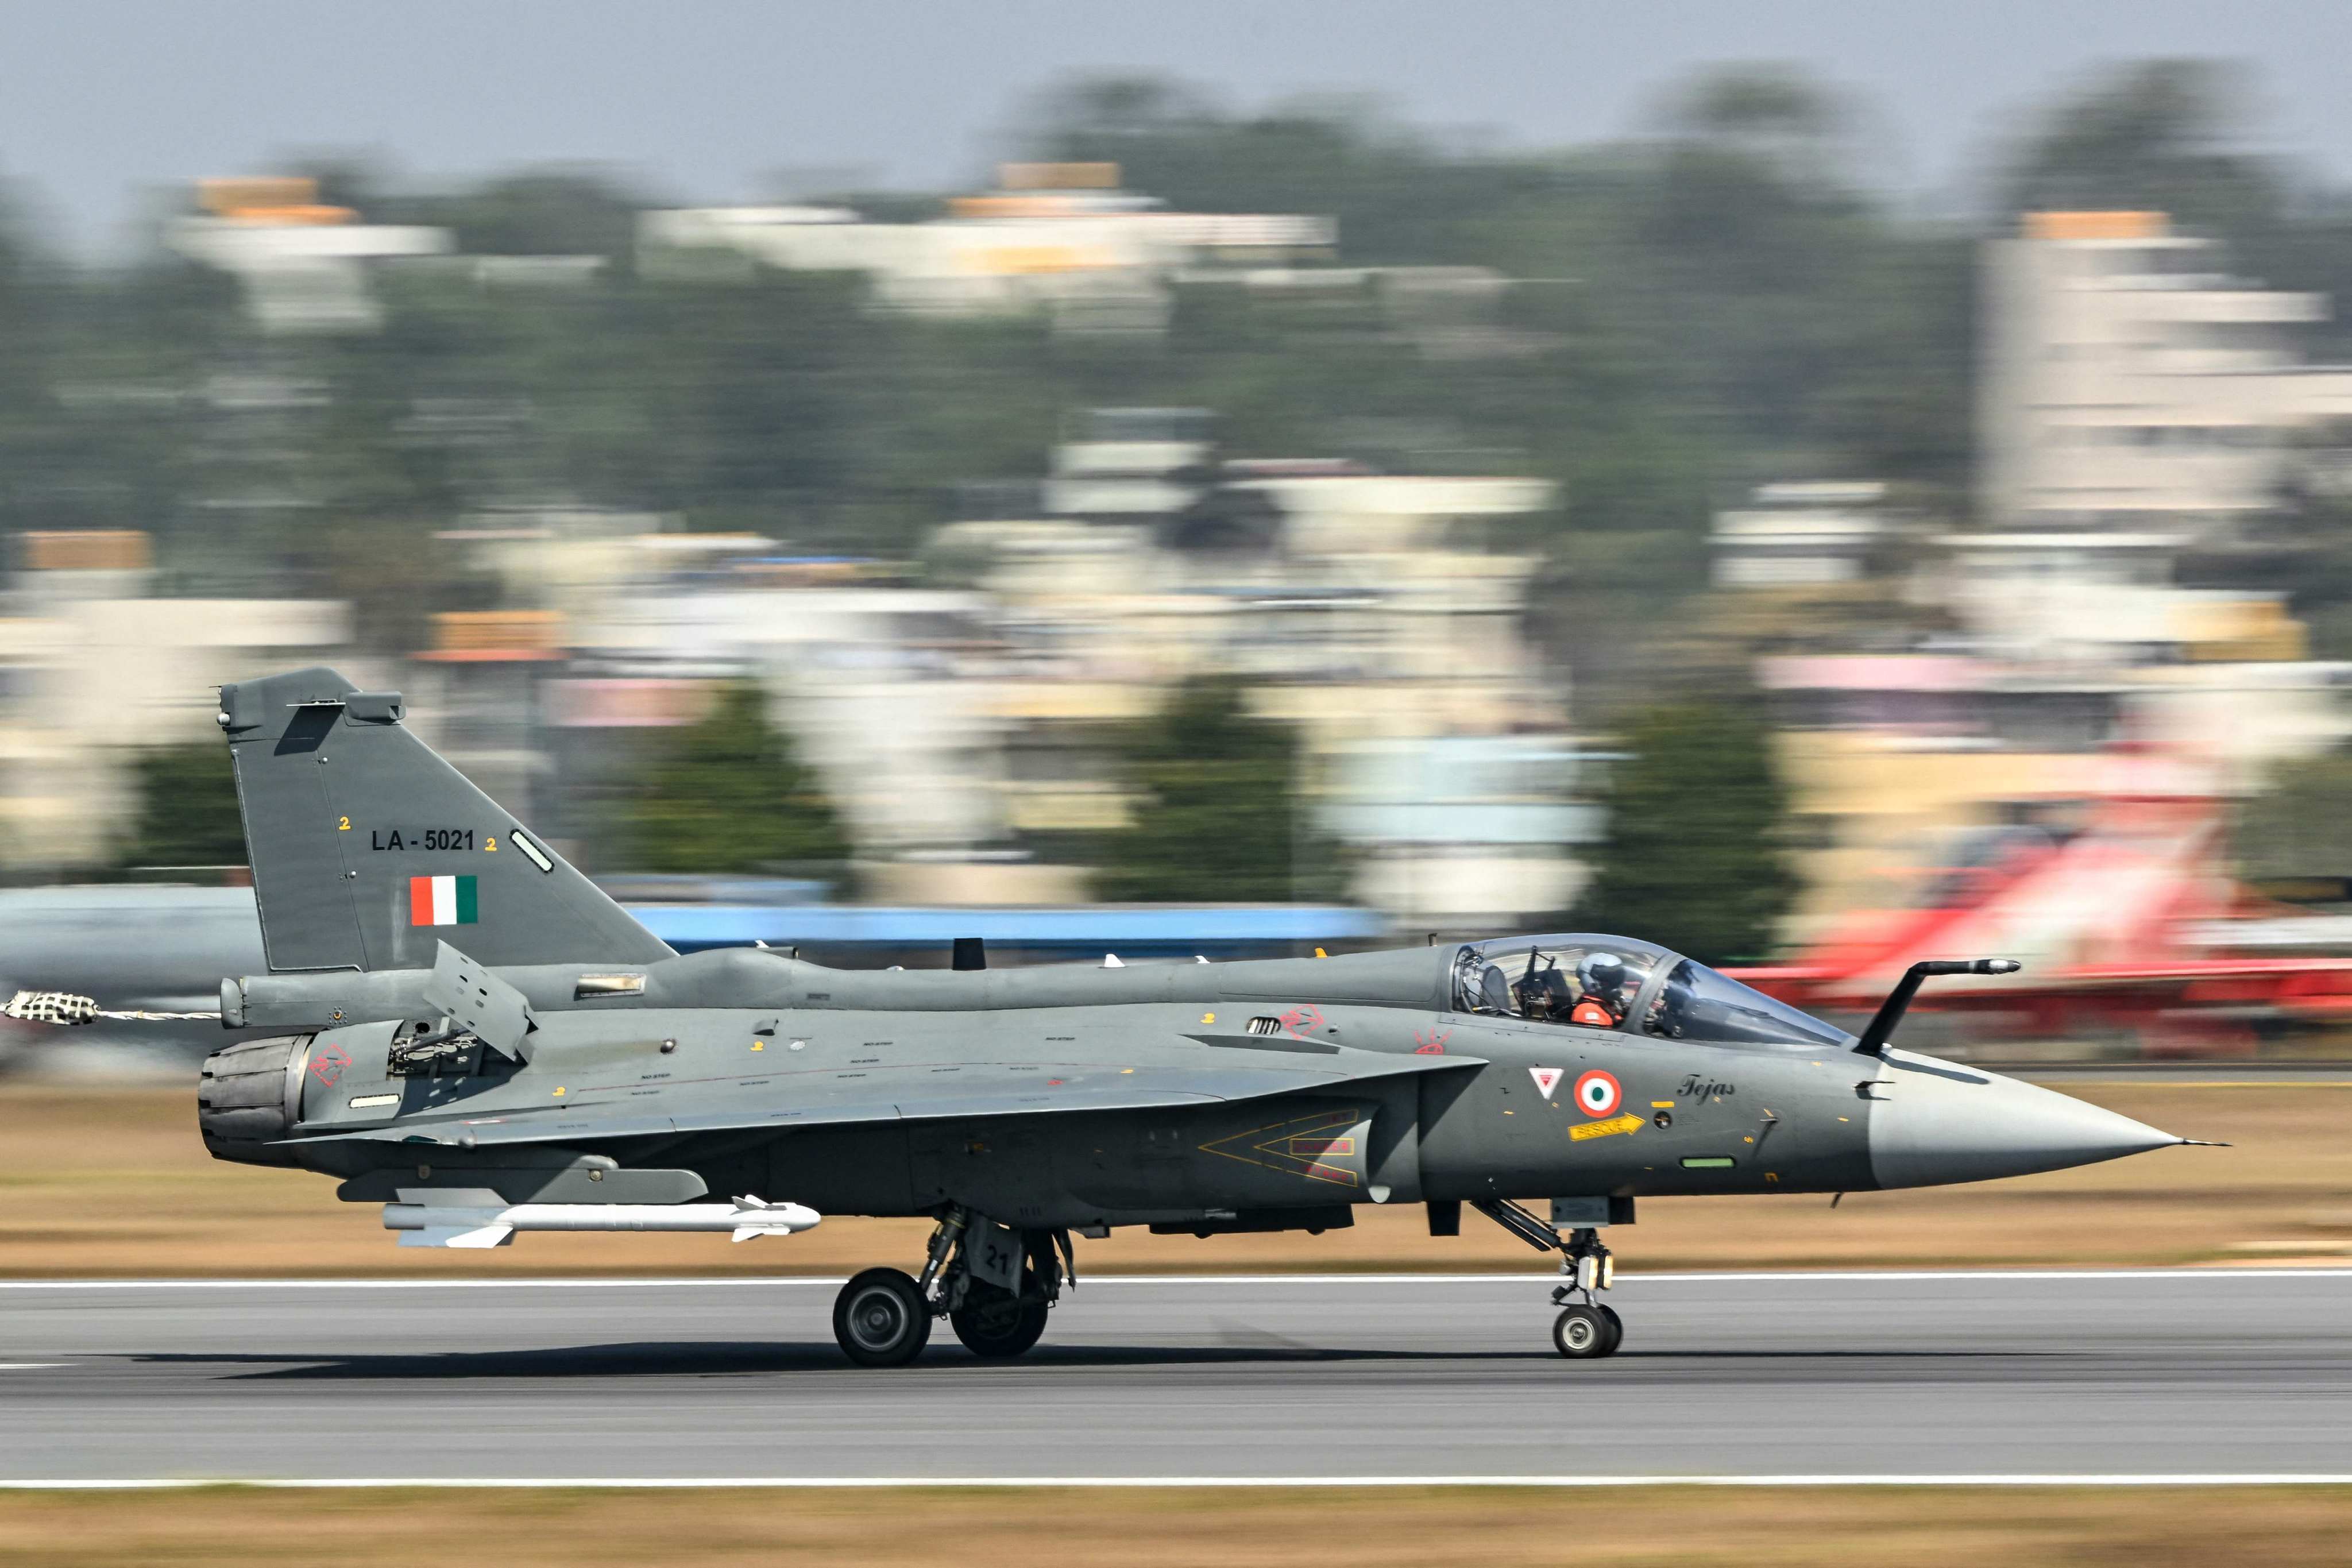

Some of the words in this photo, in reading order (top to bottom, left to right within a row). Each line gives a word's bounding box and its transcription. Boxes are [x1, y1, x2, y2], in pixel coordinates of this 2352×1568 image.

[338, 816, 351, 831] 2
[372, 830, 404, 851] LA
[424, 829, 473, 851] 5021
[485, 837, 497, 851] 2
[1677, 1073, 1736, 1106] Tejas
[986, 1243, 1008, 1276] 21
